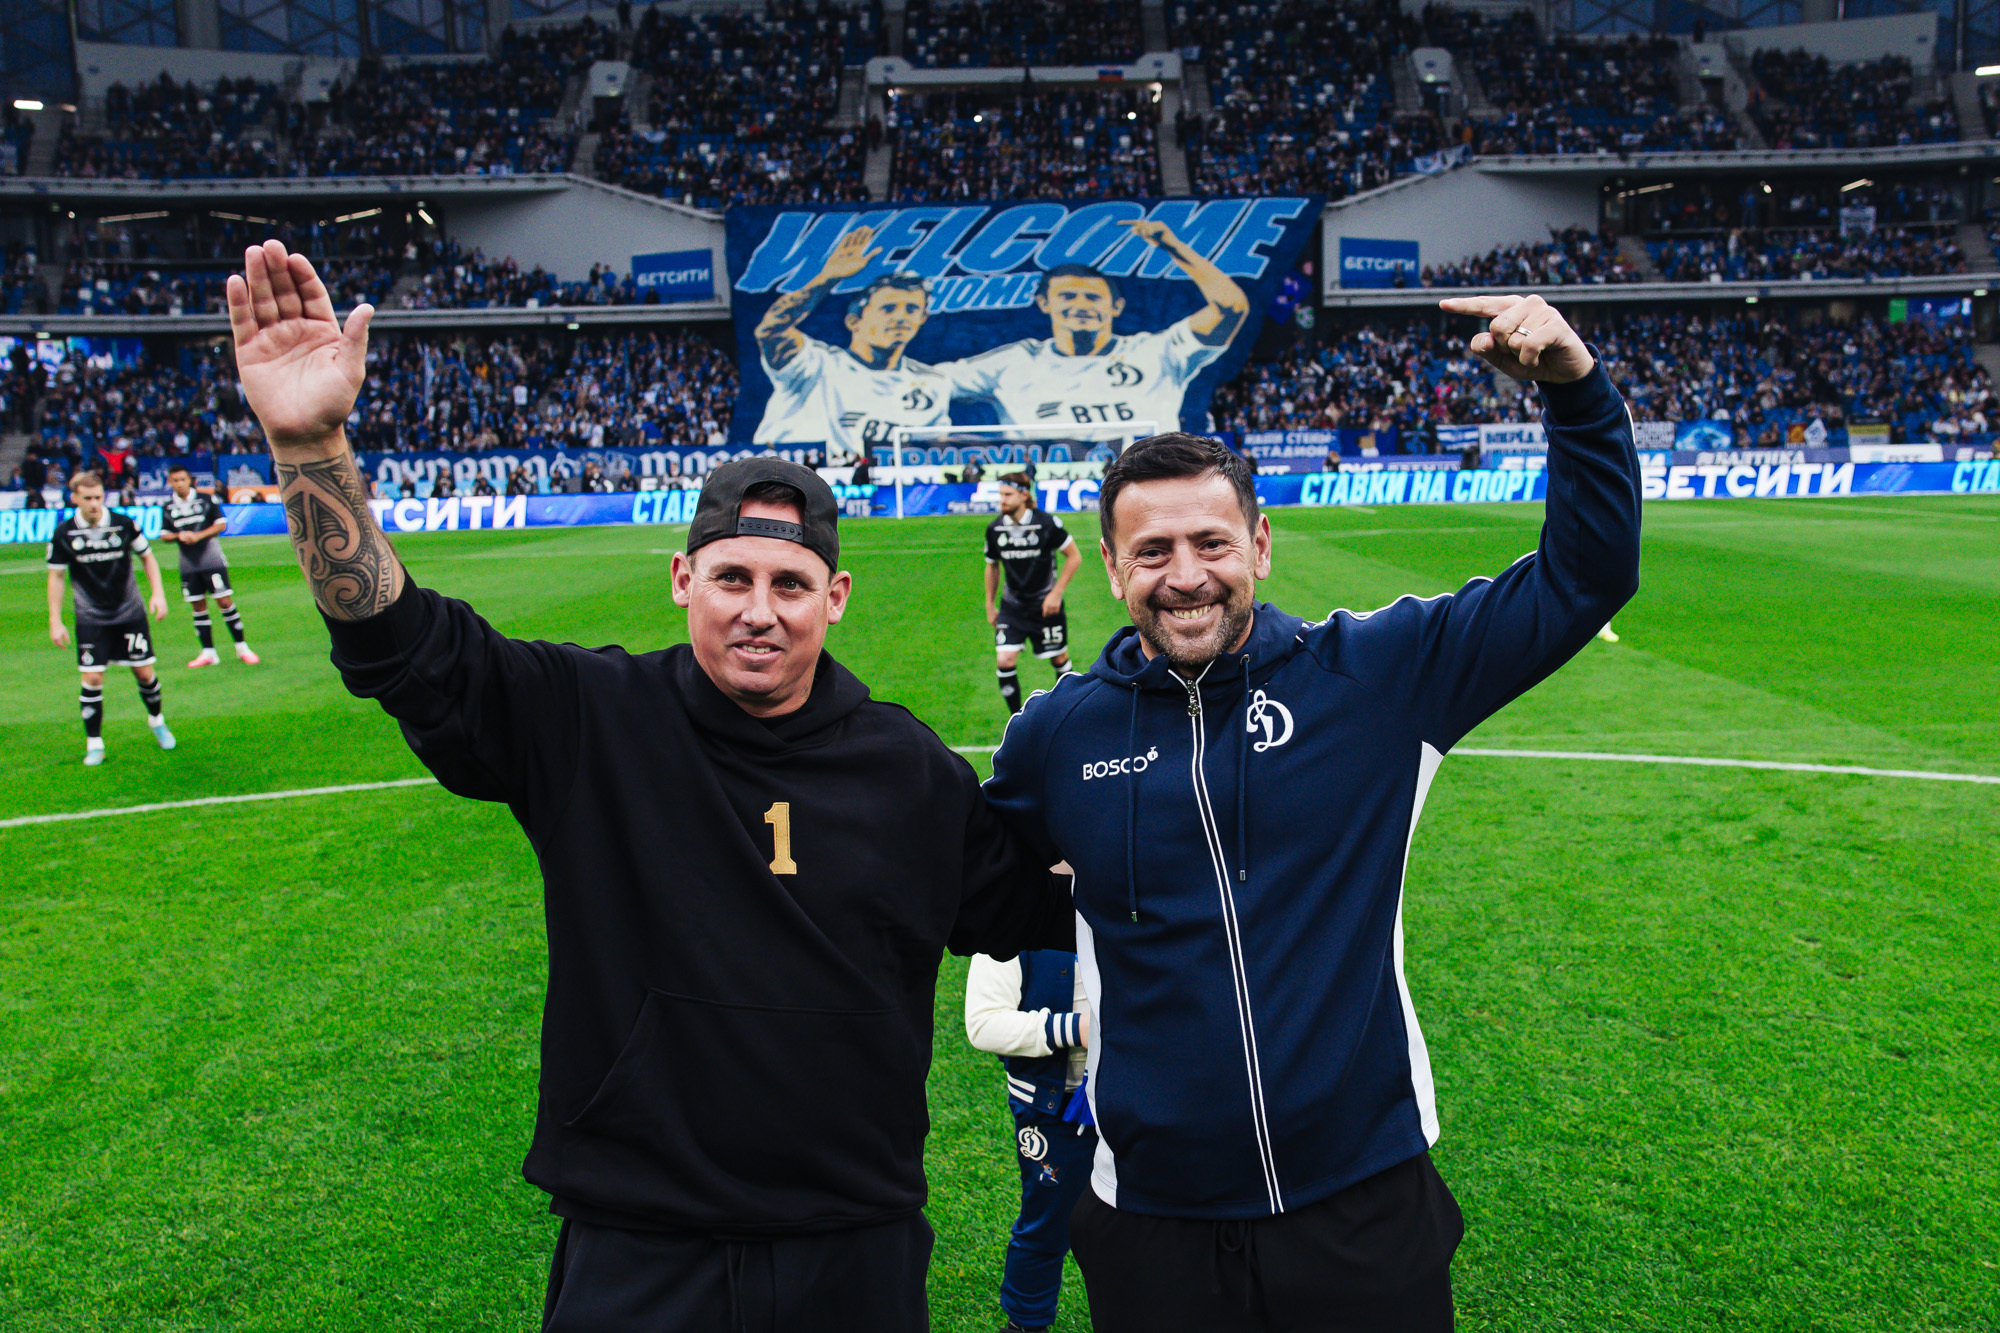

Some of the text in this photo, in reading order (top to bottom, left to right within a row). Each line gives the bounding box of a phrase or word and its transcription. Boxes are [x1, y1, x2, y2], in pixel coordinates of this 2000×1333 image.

[734, 198, 1308, 294] WELCOME
[926, 272, 1043, 315] HOME
[1071, 402, 1134, 423] ВТБ
[1301, 468, 1542, 506] СТАВКИ НА СПОРТ
[1641, 462, 1855, 499] БЕТСИТИ
[124, 632, 149, 653] 74
[1042, 625, 1063, 644] 15
[1083, 756, 1148, 780] BOSCO
[764, 802, 797, 875] 1
